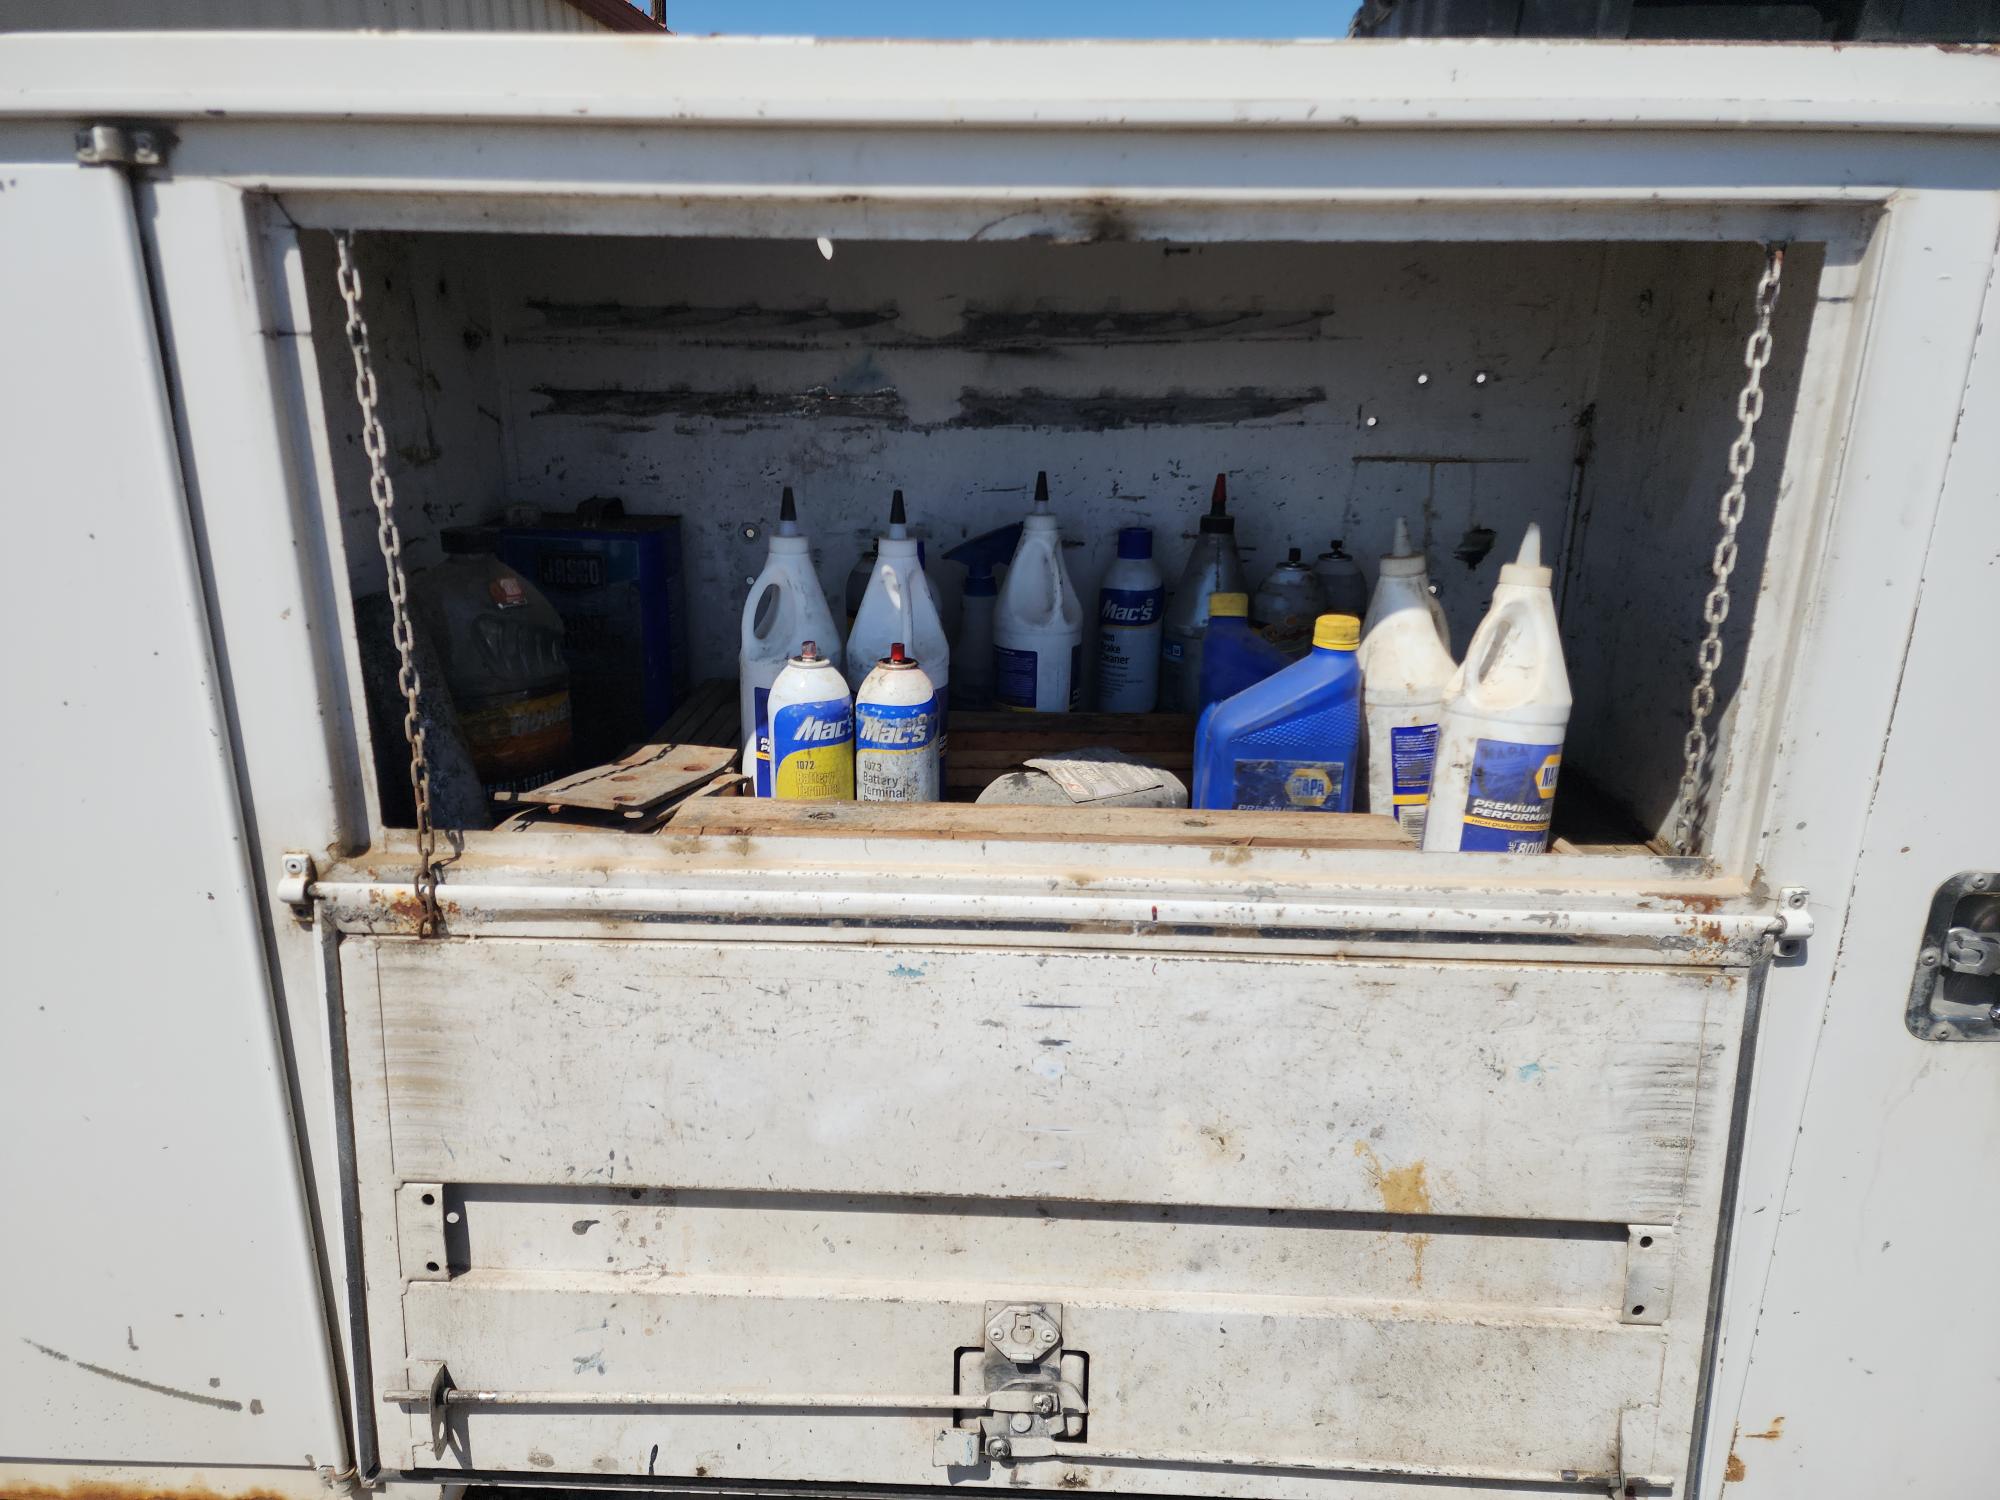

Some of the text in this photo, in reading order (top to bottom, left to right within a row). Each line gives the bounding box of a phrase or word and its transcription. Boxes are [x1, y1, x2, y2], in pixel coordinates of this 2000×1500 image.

[1102, 599, 1153, 621] Mac's
[860, 716, 927, 744] Mac's
[797, 760, 815, 770] 1072
[863, 760, 882, 771] 1073
[863, 770, 899, 789] Battery
[863, 784, 906, 799] Terminal
[1473, 798, 1541, 814] PREMIUM
